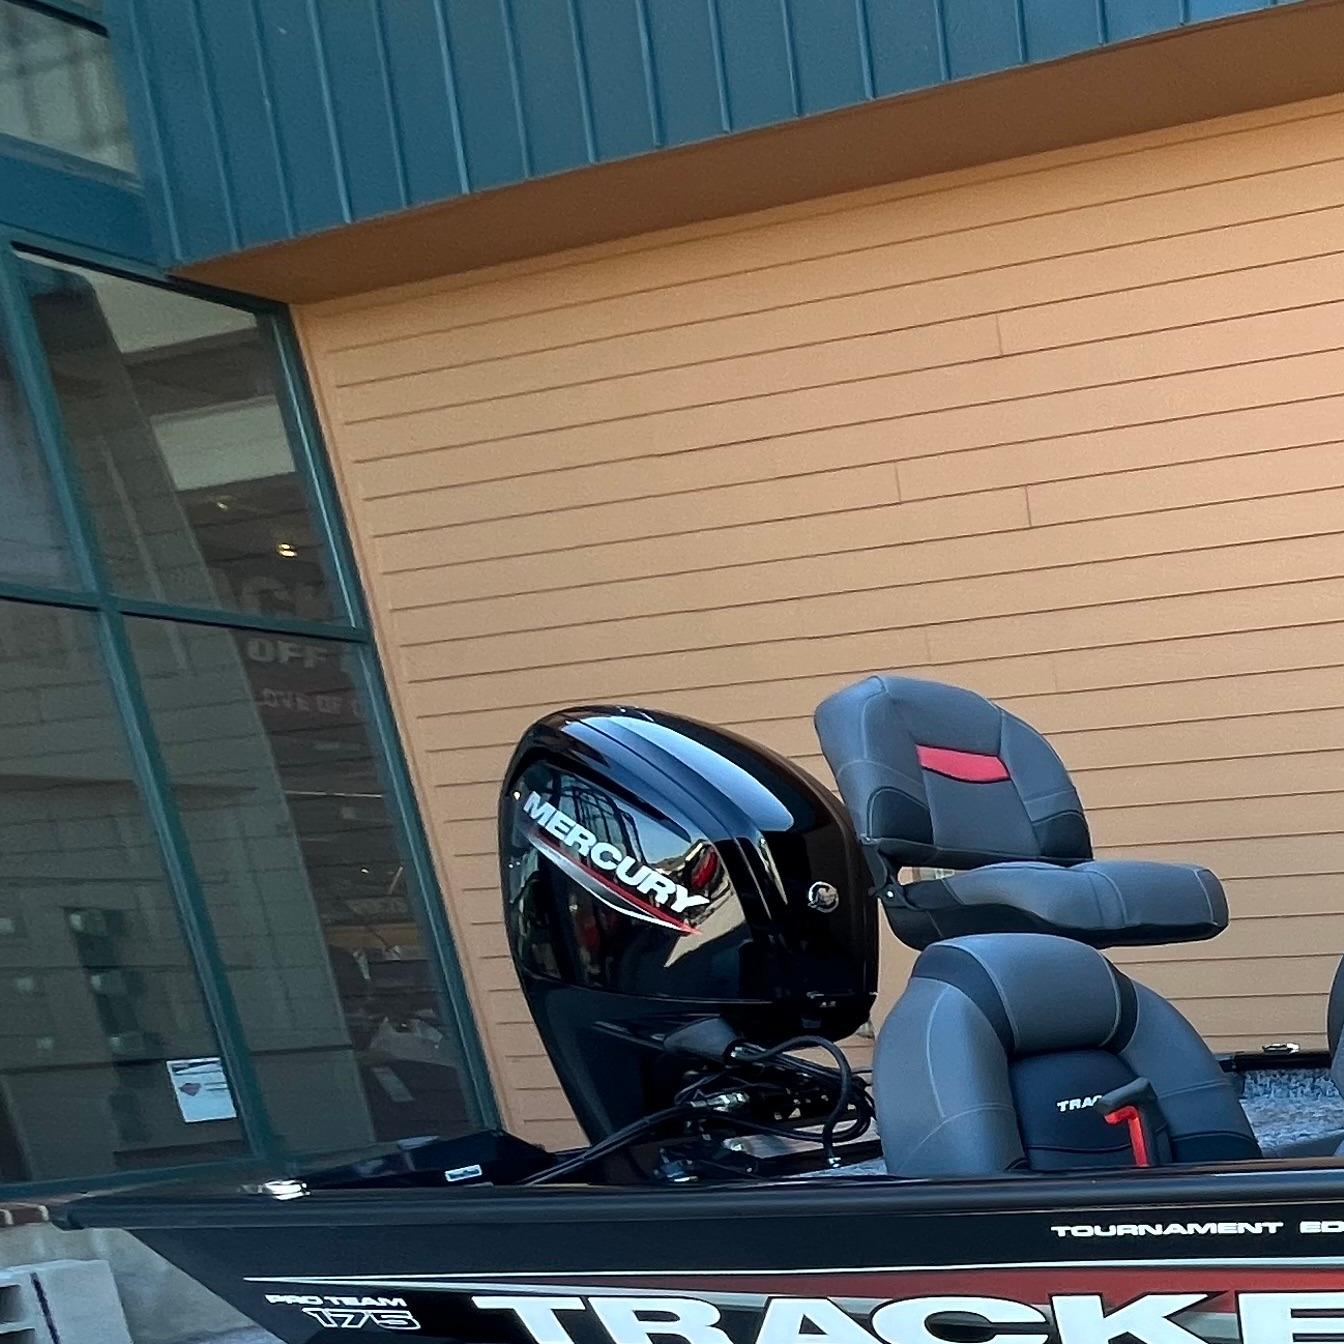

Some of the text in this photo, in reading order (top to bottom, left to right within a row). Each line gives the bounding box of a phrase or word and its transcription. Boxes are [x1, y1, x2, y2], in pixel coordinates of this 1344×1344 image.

[247, 639, 328, 668] OFF
[523, 791, 710, 913] MERCURY
[1050, 1221, 1284, 1237] TOURNAMENT
[264, 1294, 407, 1306] PRO TEAM
[301, 1307, 422, 1330] 175
